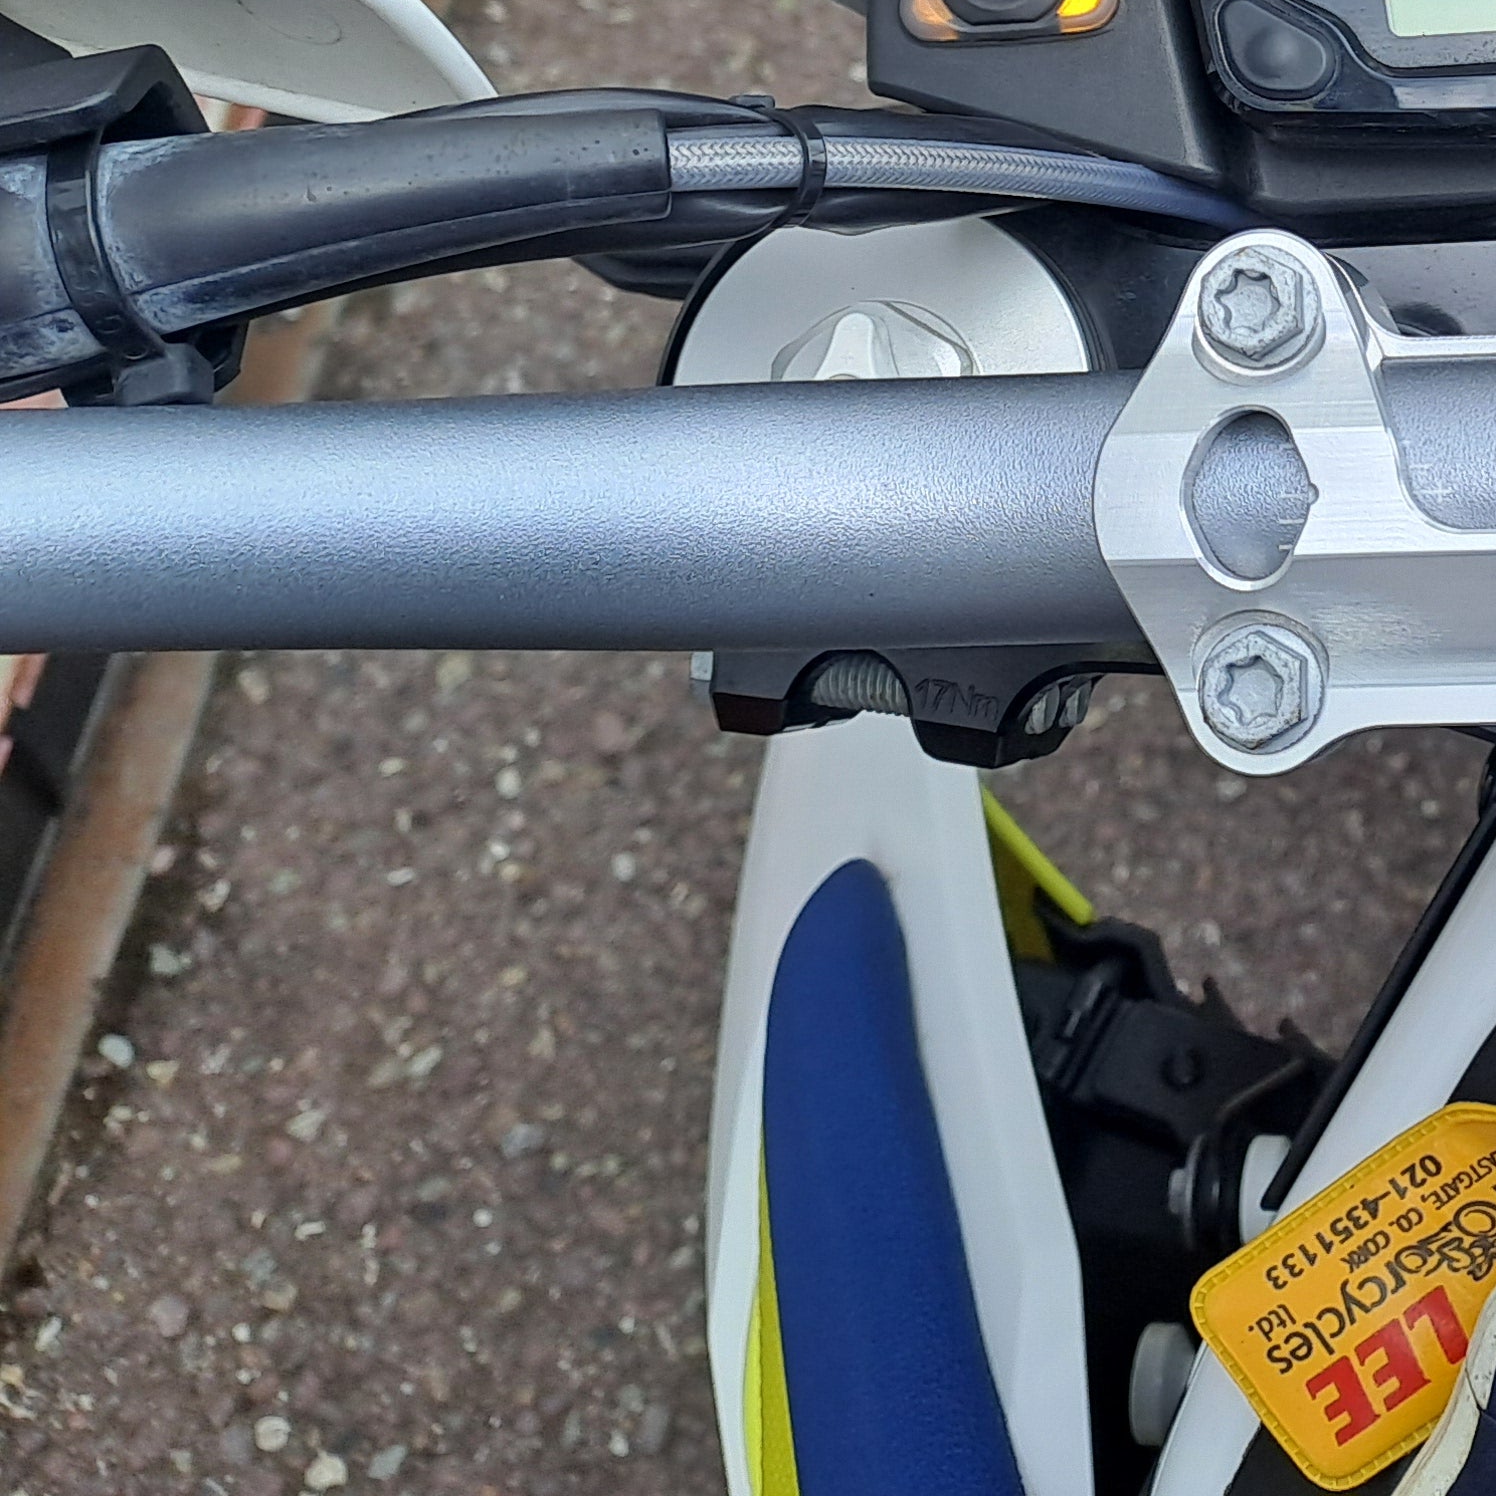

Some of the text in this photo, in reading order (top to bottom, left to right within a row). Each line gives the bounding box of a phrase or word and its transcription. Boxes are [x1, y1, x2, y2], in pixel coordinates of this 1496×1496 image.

[914, 677, 1000, 721] 17Nm
[1265, 1154, 1444, 1290] 021-4351133
[1388, 1206, 1424, 1233] CO.
[1339, 1230, 1391, 1274] CORK
[1247, 1303, 1297, 1343] ltd.
[1305, 1284, 1470, 1448] LEE
